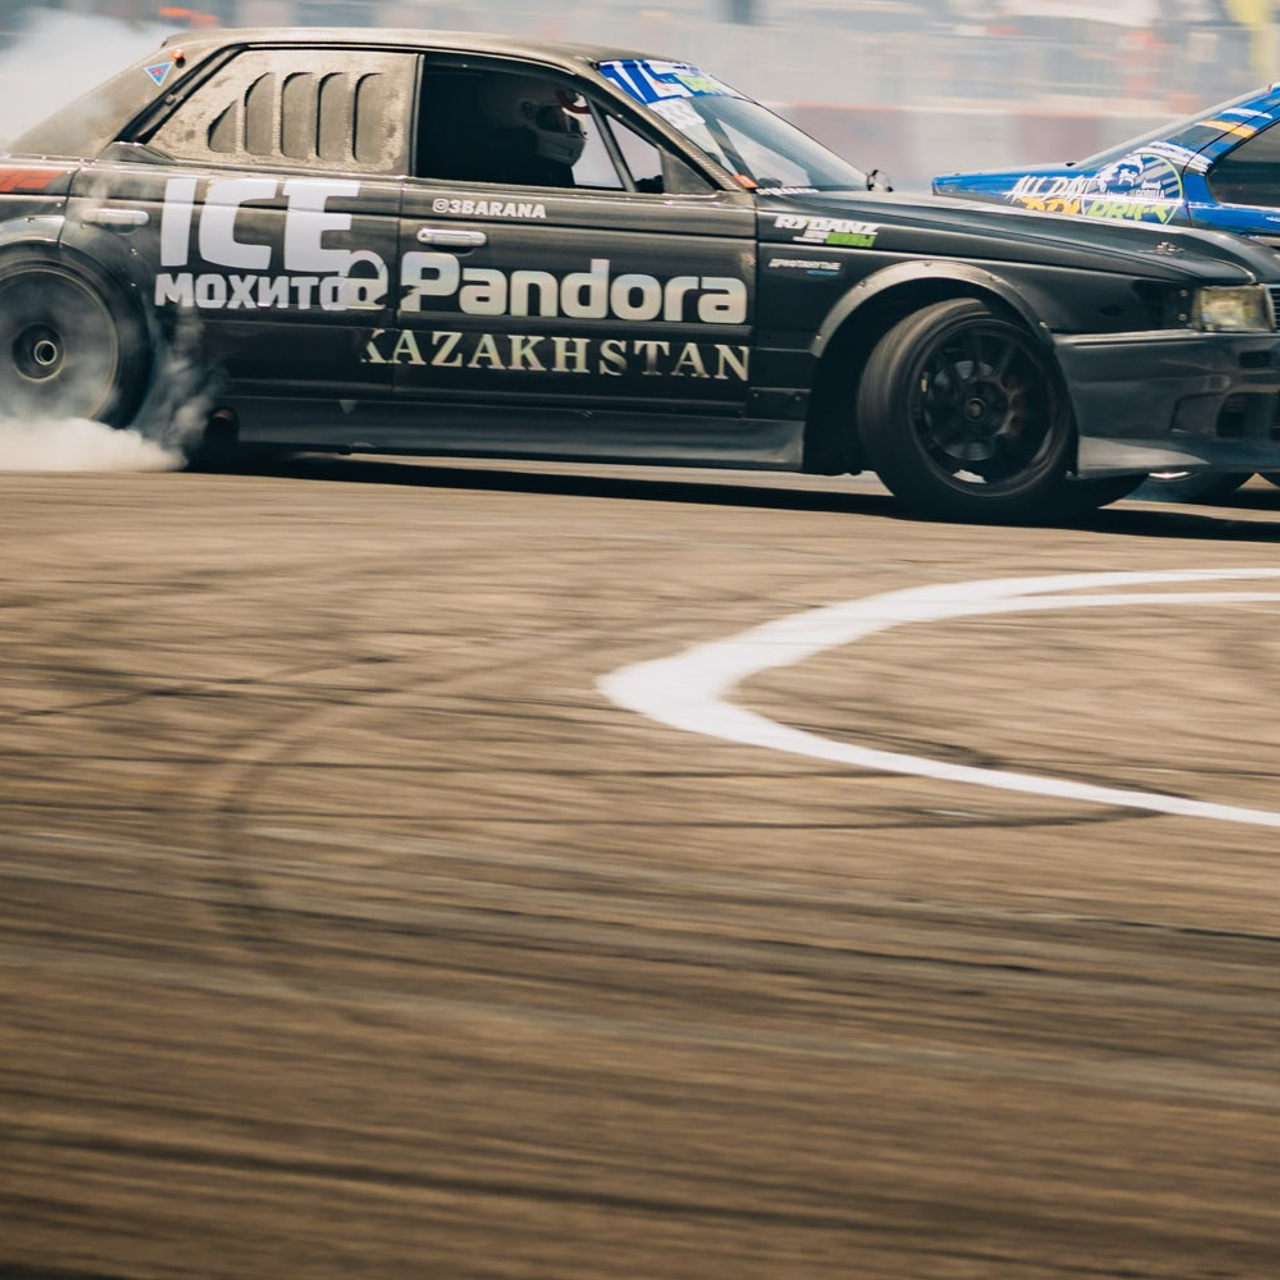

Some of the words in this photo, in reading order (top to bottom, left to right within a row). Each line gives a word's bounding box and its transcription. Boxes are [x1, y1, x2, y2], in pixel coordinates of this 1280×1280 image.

[160, 177, 362, 273] ICE
[1087, 200, 1172, 224] DRIFT
[154, 272, 358, 312] МОХИТО
[401, 251, 748, 325] Pandora
